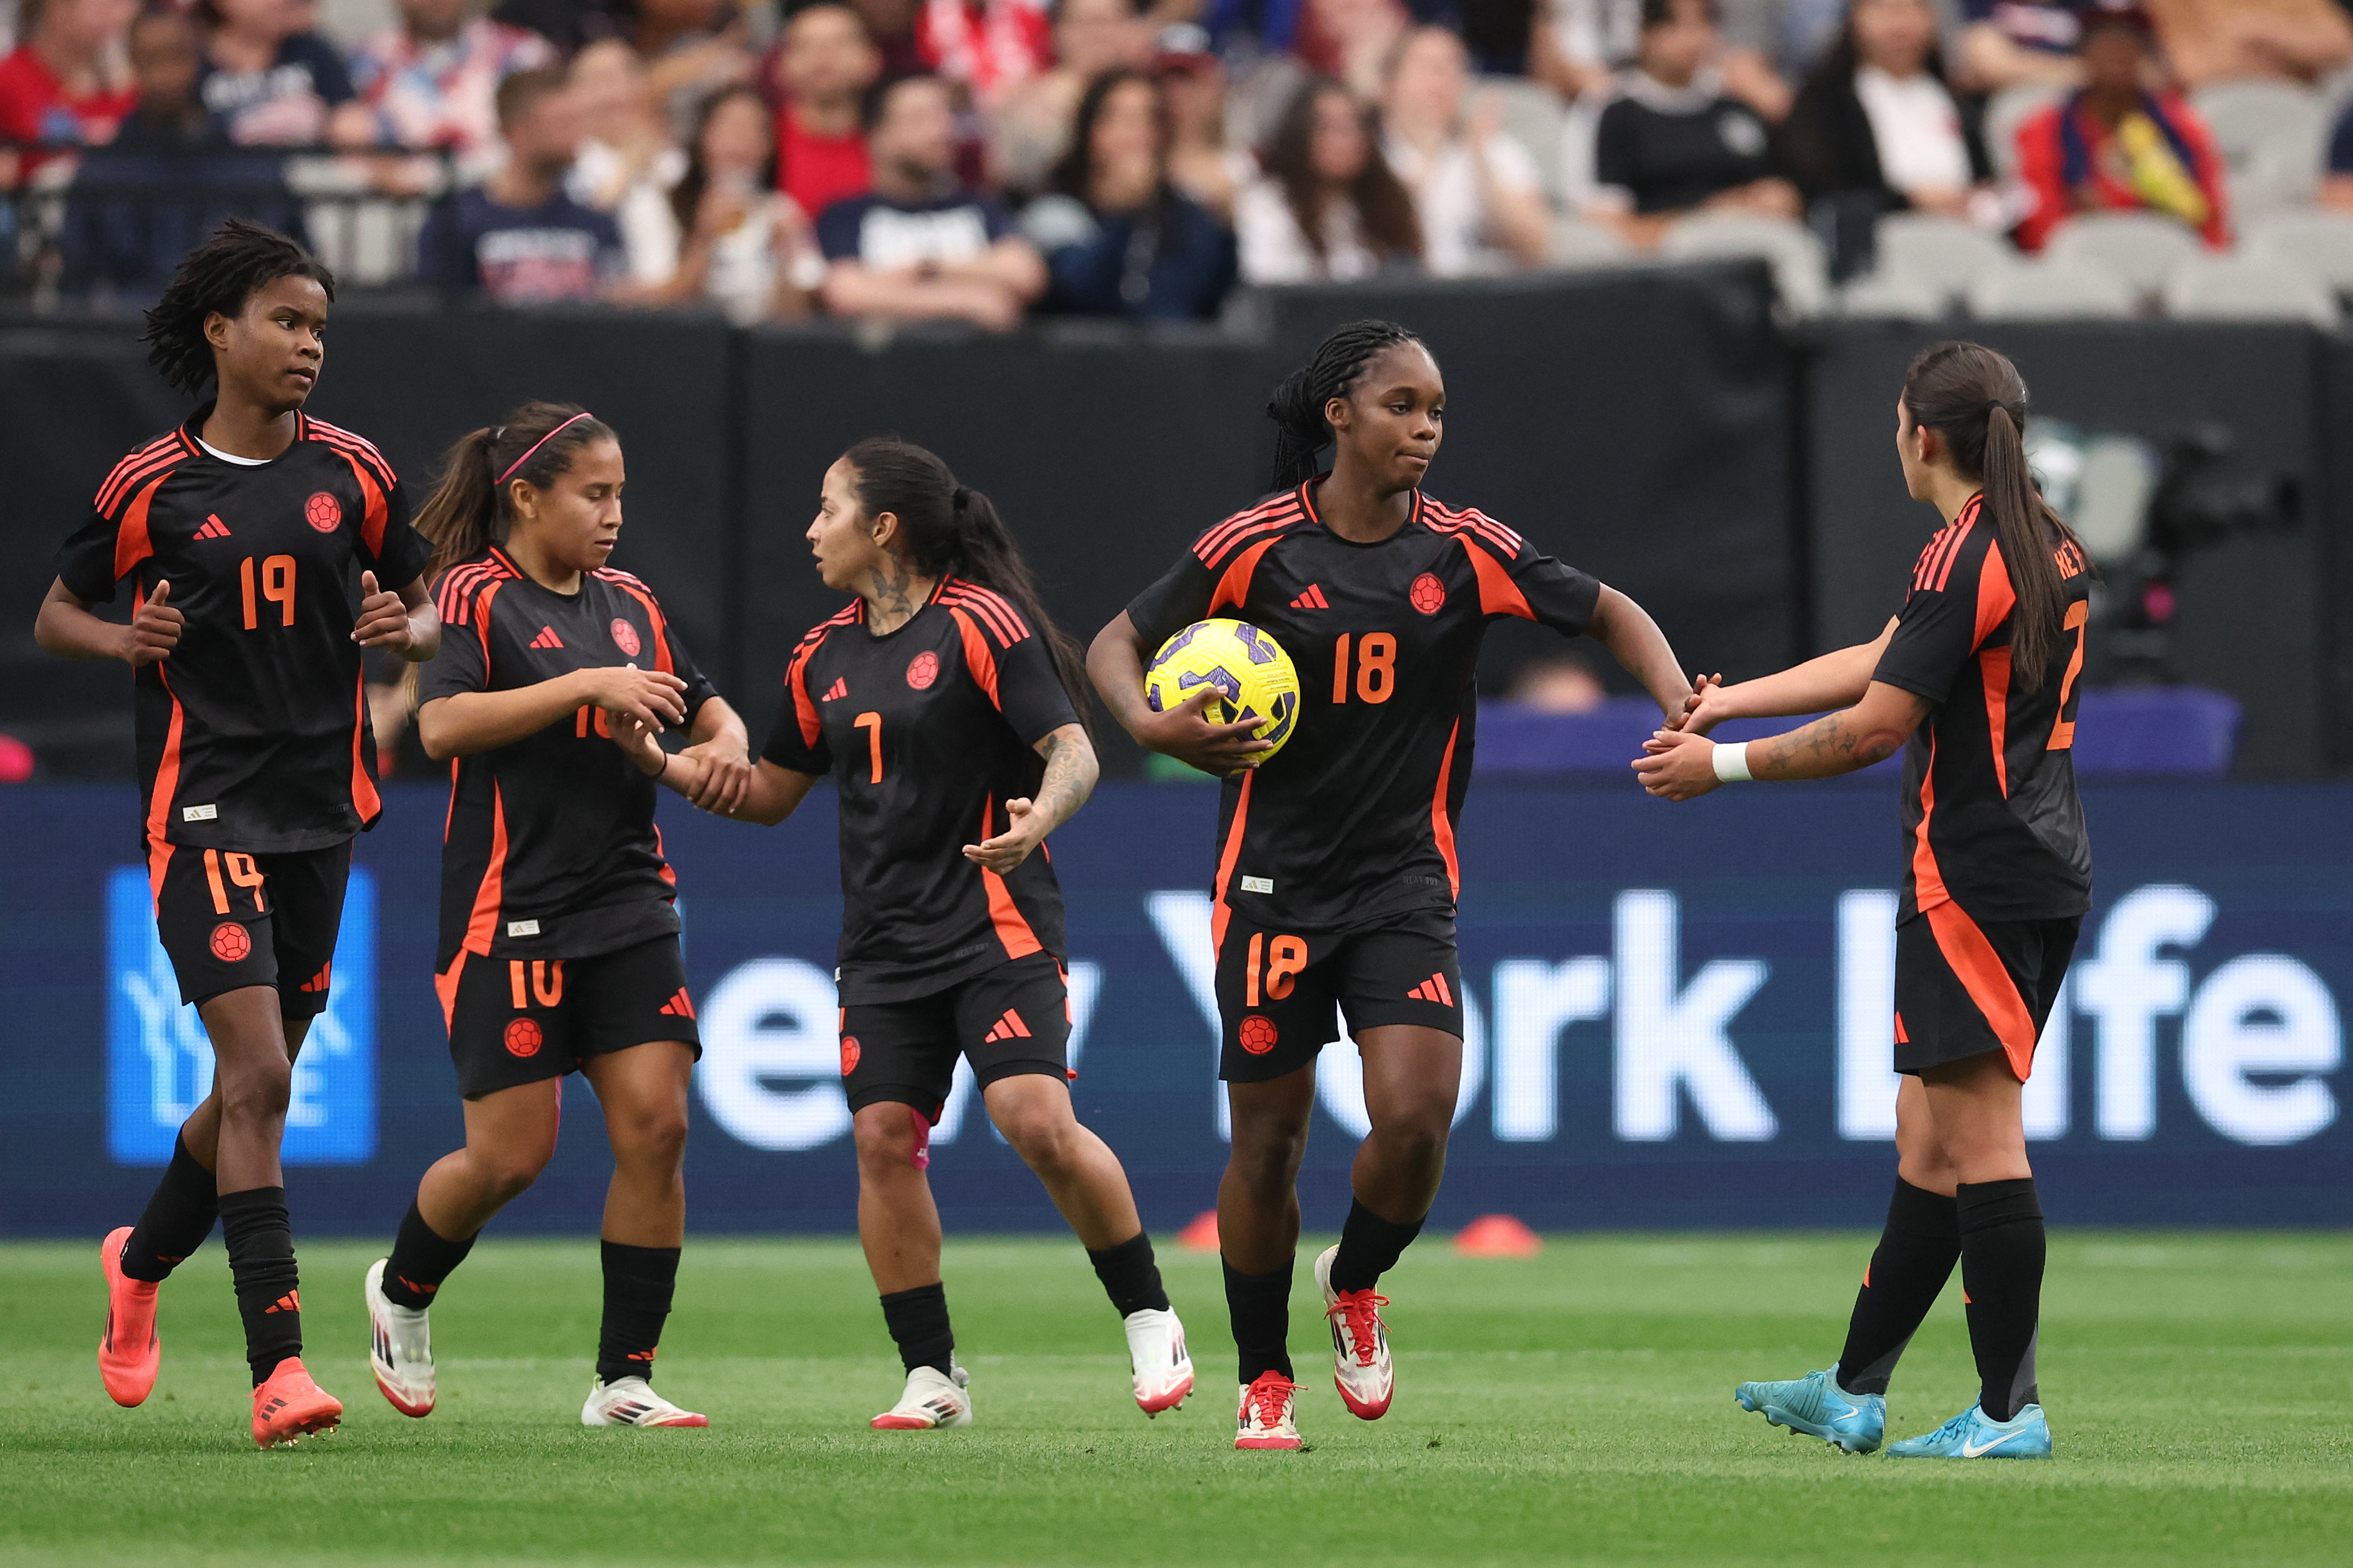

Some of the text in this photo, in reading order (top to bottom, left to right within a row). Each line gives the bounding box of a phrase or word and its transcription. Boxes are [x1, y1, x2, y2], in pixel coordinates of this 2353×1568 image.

[241, 554, 296, 630] 19
[1332, 632, 1396, 704] 18
[2046, 599, 2089, 750] 2
[853, 711, 882, 784] 7
[204, 848, 264, 915] 19
[1246, 932, 1307, 1007] 18
